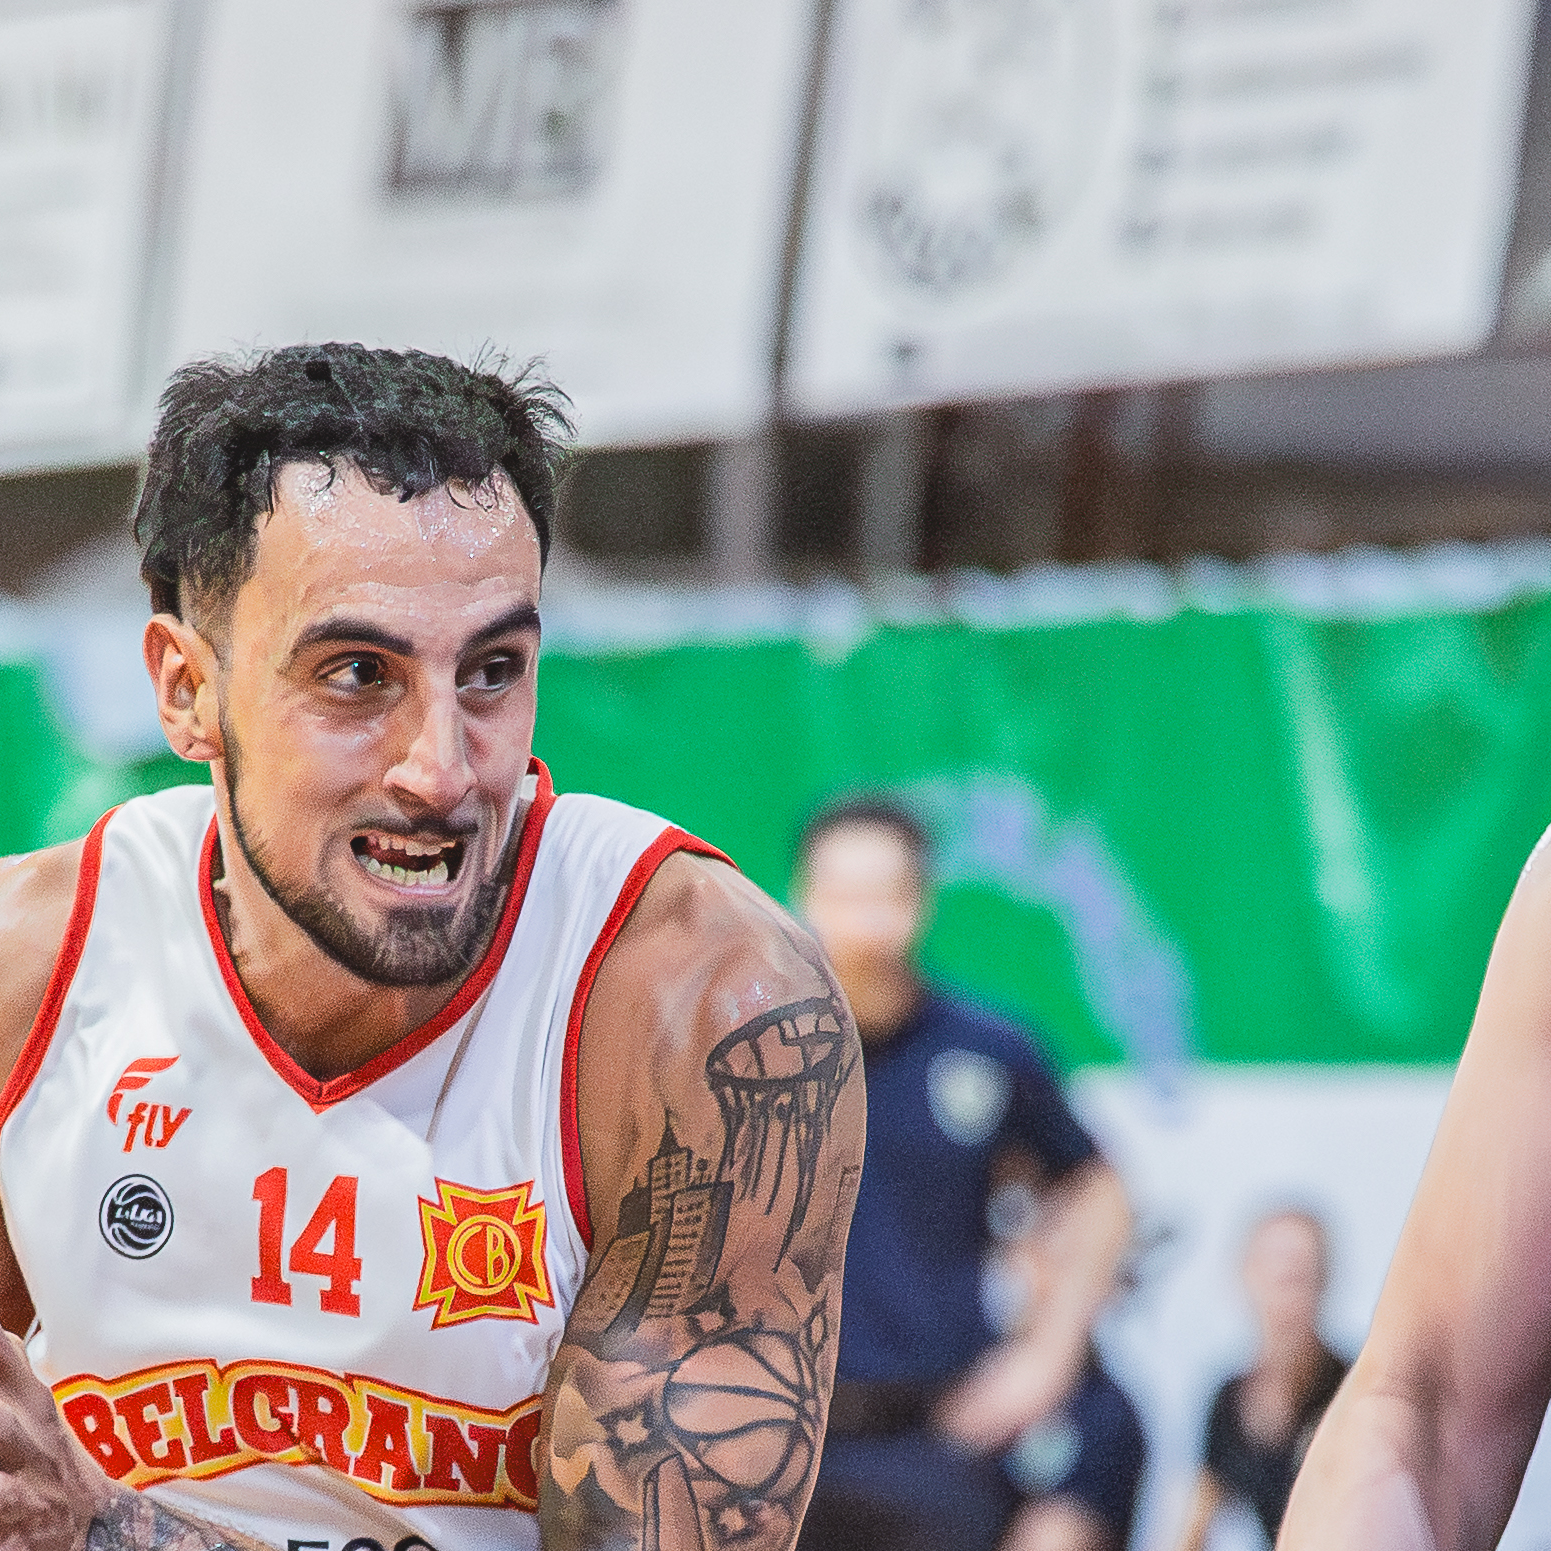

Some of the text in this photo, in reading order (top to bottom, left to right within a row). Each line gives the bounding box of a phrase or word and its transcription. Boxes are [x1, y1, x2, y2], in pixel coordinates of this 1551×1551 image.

[122, 1101, 193, 1153] fly
[250, 1165, 363, 1318] 14
[454, 1220, 509, 1284] CB
